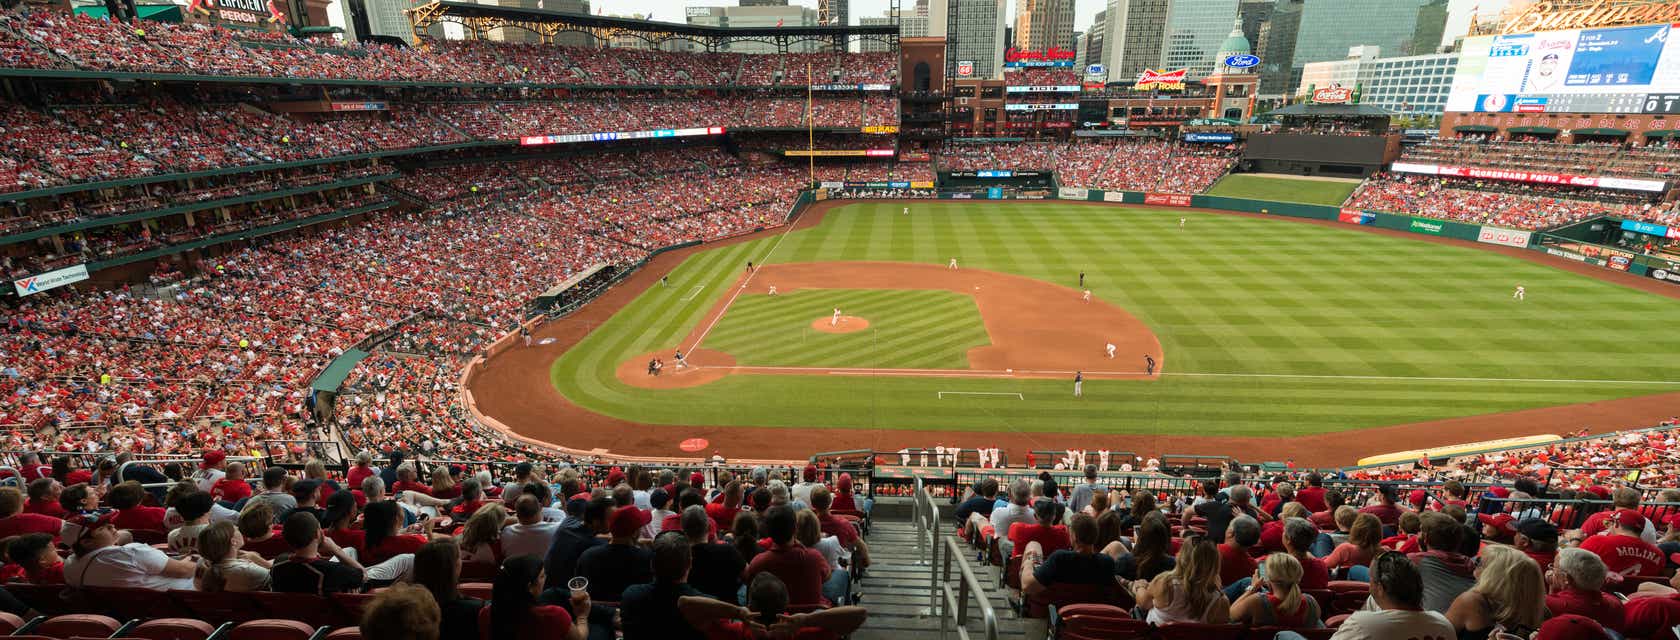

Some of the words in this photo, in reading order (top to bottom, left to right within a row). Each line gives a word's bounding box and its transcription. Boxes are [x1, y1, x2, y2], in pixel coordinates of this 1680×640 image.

[220, 9, 257, 23] PERCH
[1042, 45, 1075, 61] Nation
[1231, 55, 1253, 65] Ford
[1139, 72, 1182, 82] Budweiser
[1159, 82, 1185, 90] HOUSE
[1317, 89, 1346, 100] Coca-Cola
[1646, 100, 1657, 111] 0
[1664, 101, 1672, 112] 1
[1622, 119, 1640, 129] 42
[1647, 119, 1666, 129] 45
[1469, 169, 1528, 180] SCOREBOARD
[1420, 222, 1442, 230] National
[1616, 546, 1661, 565] MOLINA
